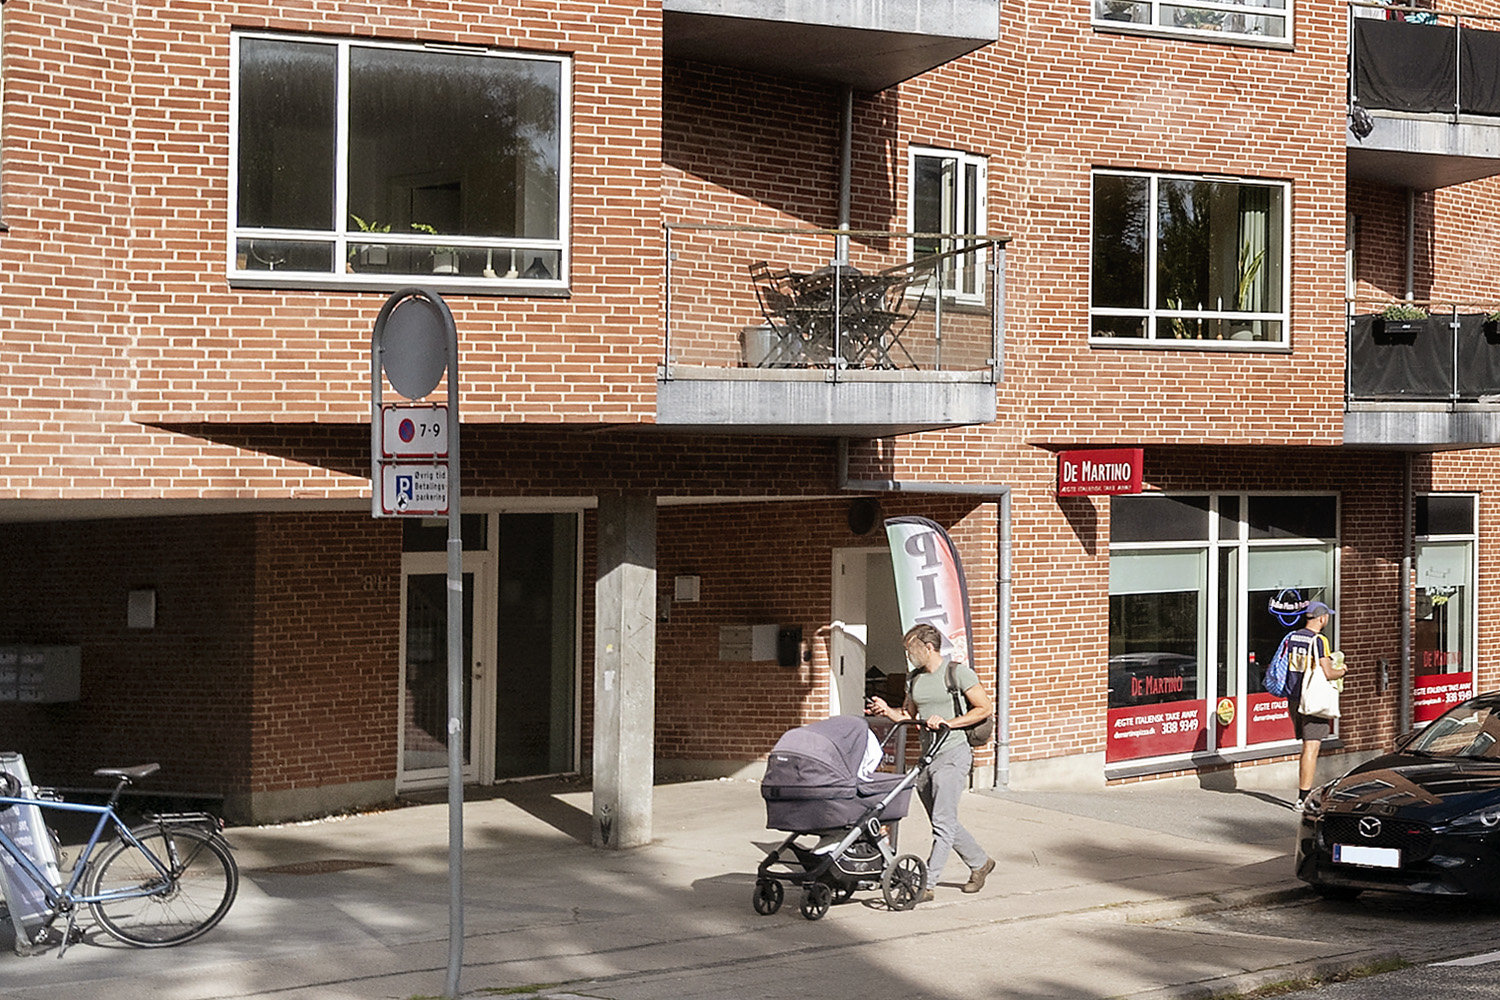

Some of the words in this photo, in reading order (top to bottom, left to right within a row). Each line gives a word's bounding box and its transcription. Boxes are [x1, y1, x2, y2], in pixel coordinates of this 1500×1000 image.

[420, 423, 441, 437] 7-9
[436, 471, 446, 479] tid
[416, 493, 446, 502] parkering
[1114, 717, 1134, 728] ÆGTE
[1135, 714, 1164, 725] ITALIENSK
[1165, 712, 1180, 721] TAKE
[1181, 709, 1198, 719] AWAY
